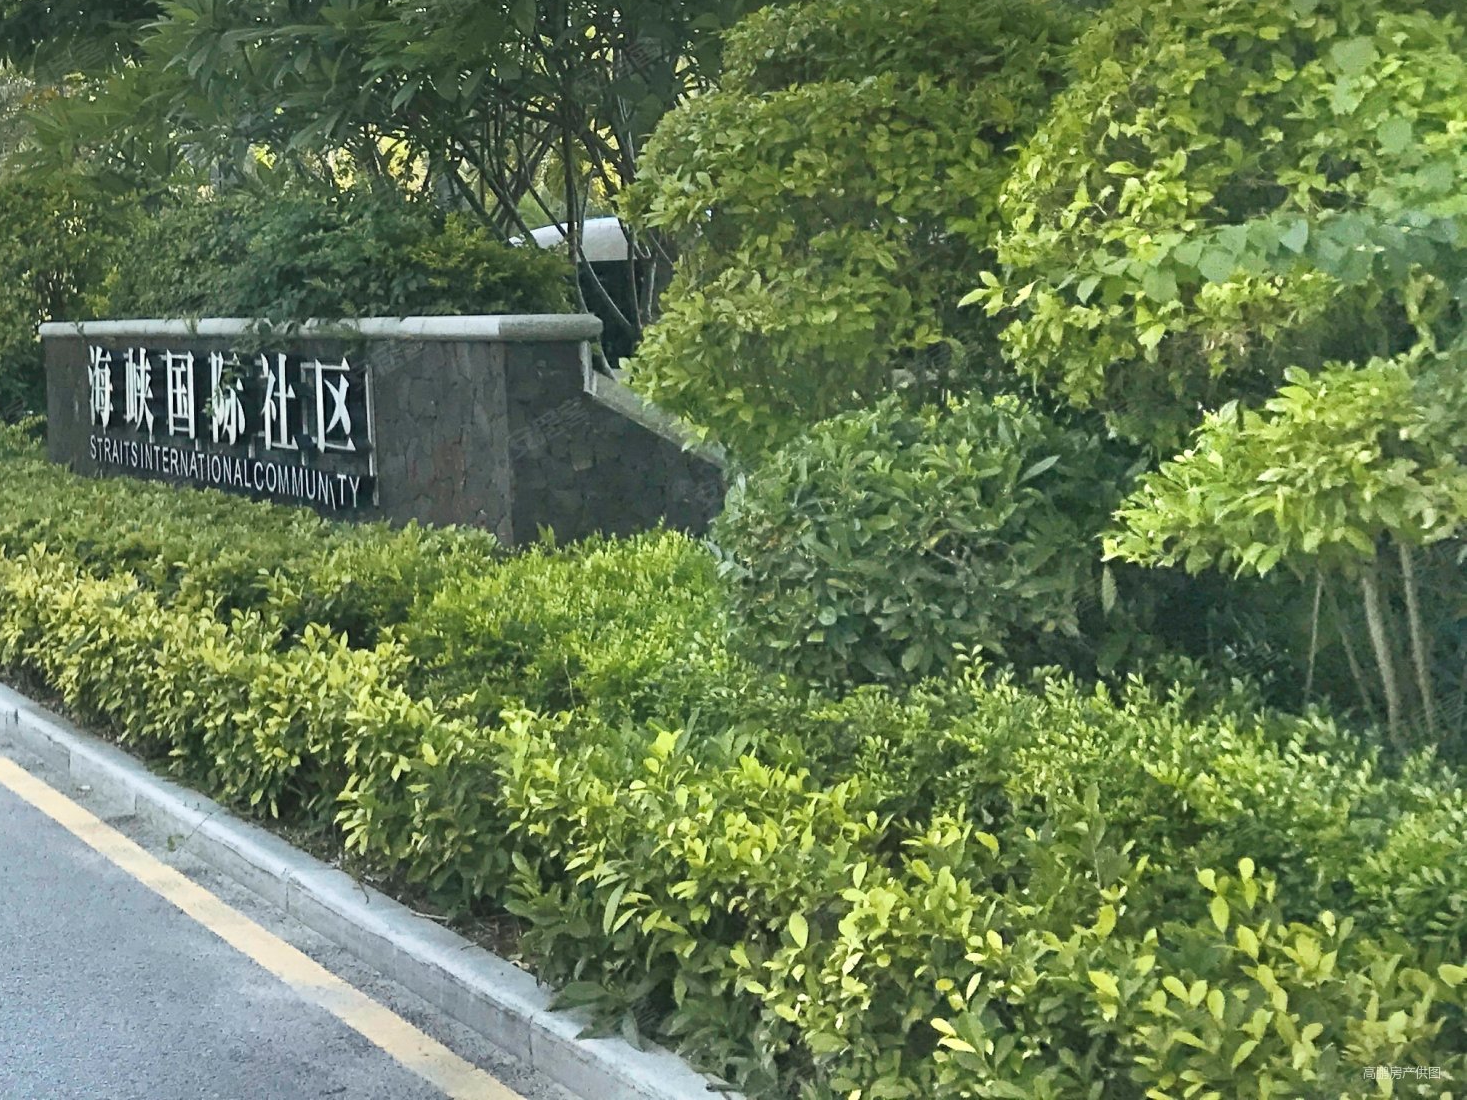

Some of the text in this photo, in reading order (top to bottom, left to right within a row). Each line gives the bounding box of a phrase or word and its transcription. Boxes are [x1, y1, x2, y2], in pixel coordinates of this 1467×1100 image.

[87, 345, 357, 453] 海峡国际社区
